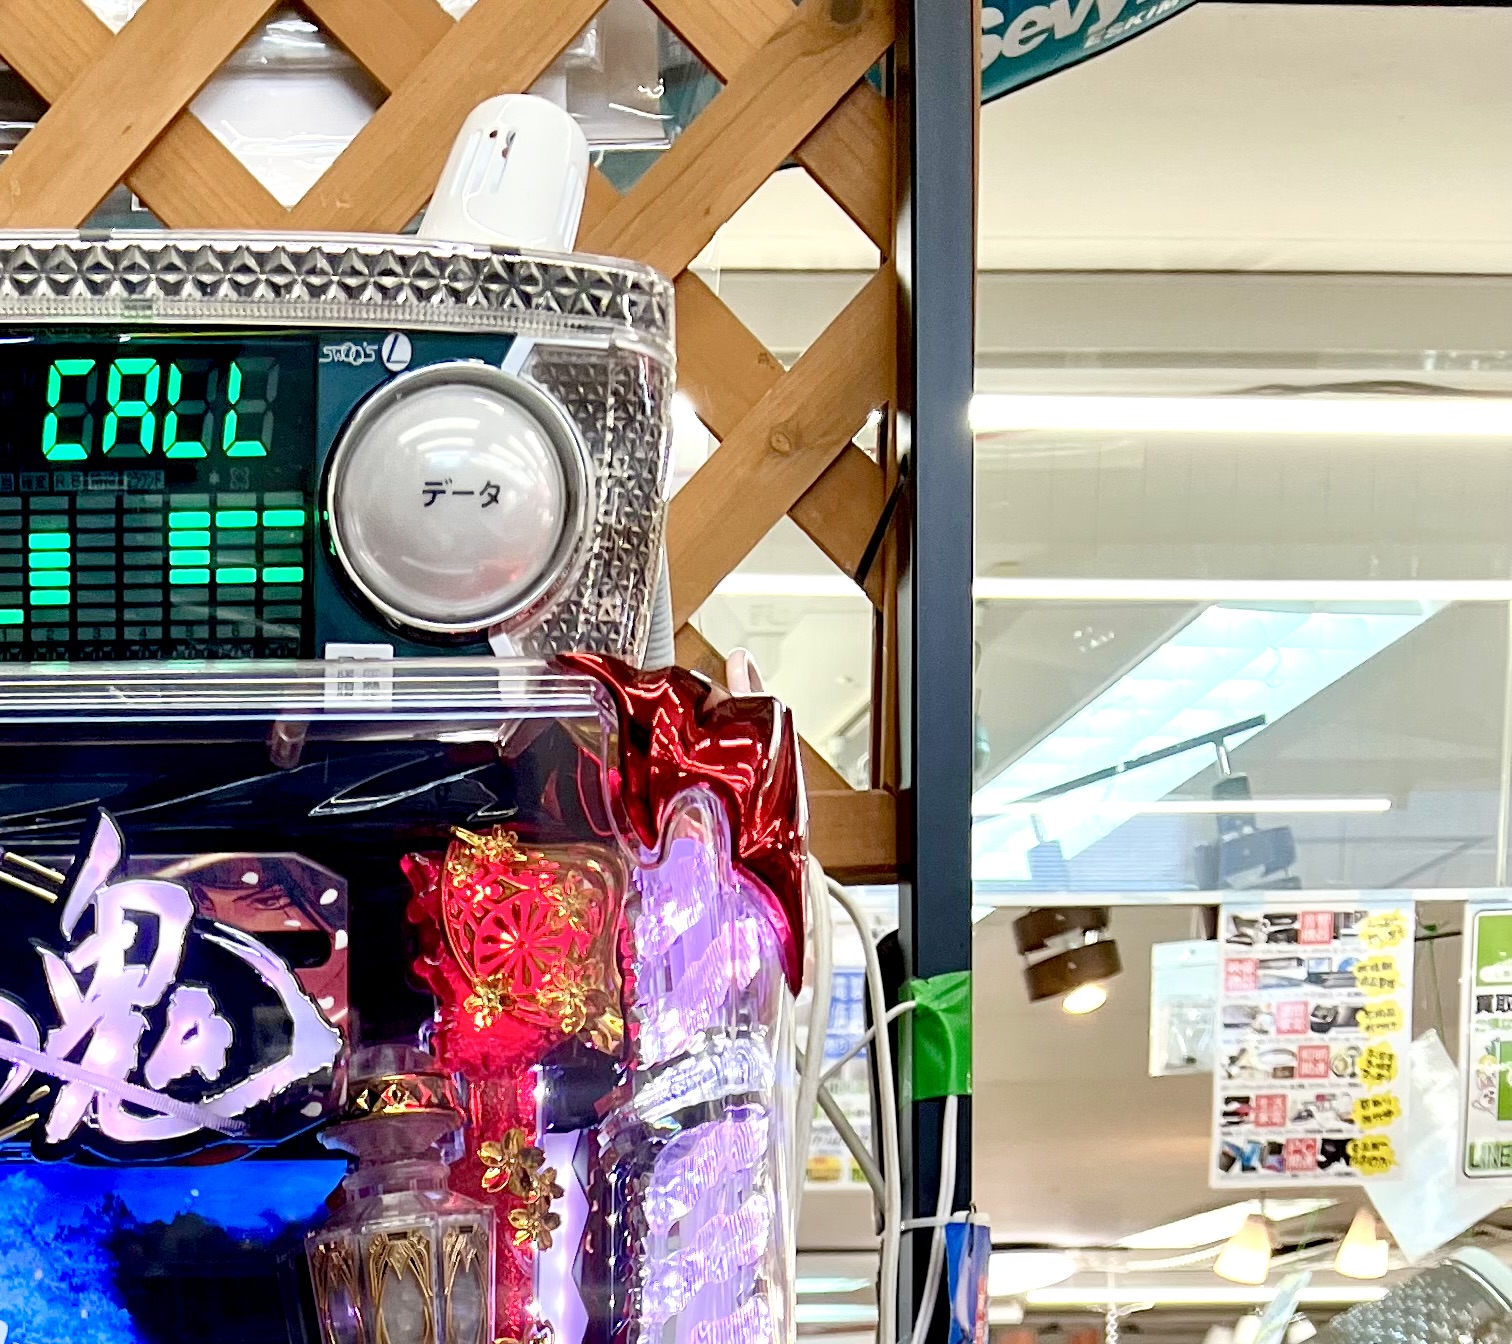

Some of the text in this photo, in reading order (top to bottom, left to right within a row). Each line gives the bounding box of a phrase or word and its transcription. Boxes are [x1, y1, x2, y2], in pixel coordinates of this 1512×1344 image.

[41, 357, 268, 461] CALL
[421, 477, 502, 508] データ
